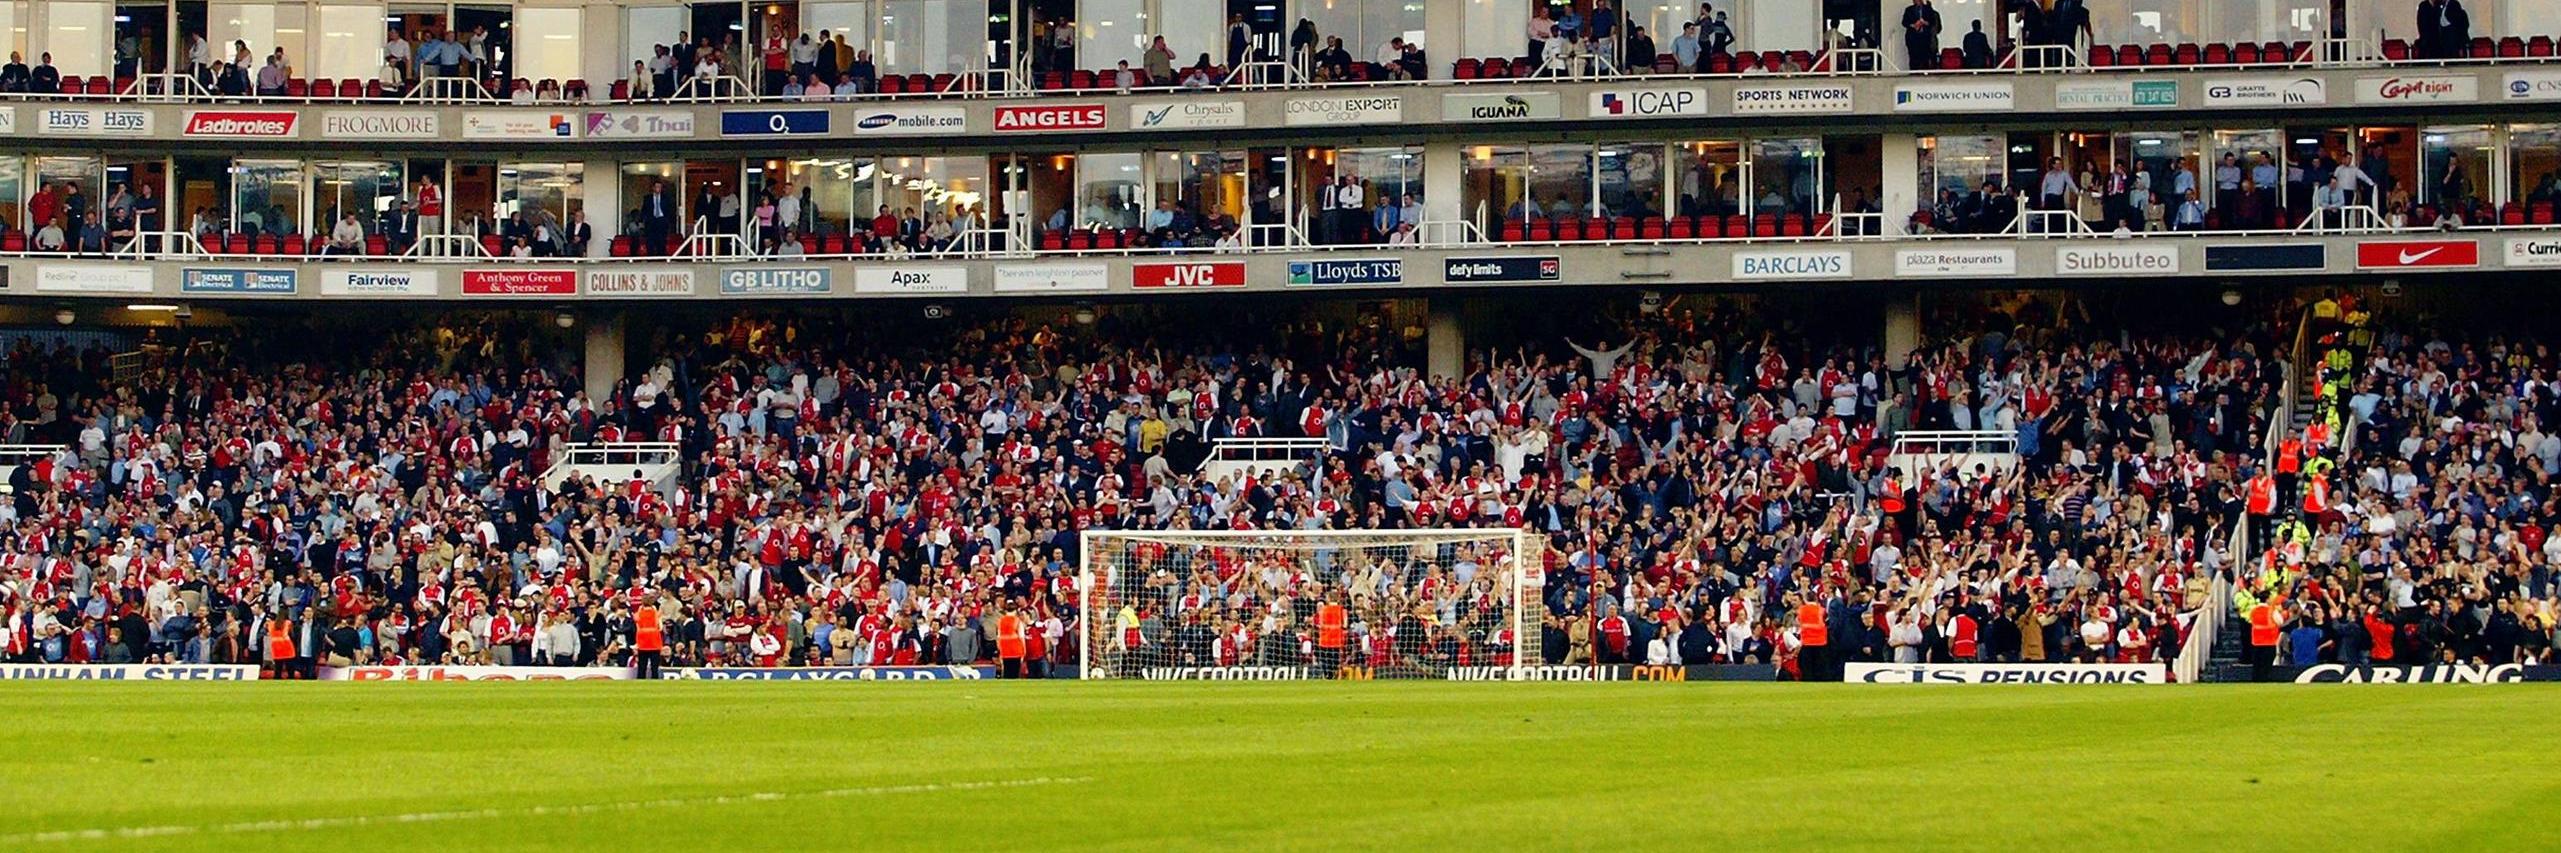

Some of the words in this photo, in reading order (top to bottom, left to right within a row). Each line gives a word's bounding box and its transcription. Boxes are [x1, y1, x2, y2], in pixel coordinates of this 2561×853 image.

[1631, 91, 1694, 114] ICAP
[1736, 90, 1783, 102] SPORTS
[1788, 89, 1849, 101] NETWORK
[1916, 92, 1970, 101] NORWICH
[1974, 91, 2010, 100] UNION
[1184, 102, 1235, 118] Chrysalis
[1287, 100, 1342, 114] LONDON
[1345, 98, 1400, 112] EXPORT
[1472, 106, 1527, 118] IGUANA
[50, 111, 89, 130] Hays
[104, 111, 144, 131] Hays
[193, 118, 286, 135] Ladbrokes
[327, 116, 434, 134] FROGMORE
[645, 115, 691, 133] Thai
[898, 115, 964, 127] mobile.com
[997, 109, 1103, 128] ANGELS
[1743, 256, 1842, 274] BARCLAYS
[1906, 253, 1936, 266] plaza
[1938, 255, 2003, 264] Restaurants
[2065, 252, 2170, 270] Subbuteo
[476, 272, 526, 285] Anthony
[528, 272, 562, 283] Green
[729, 271, 759, 287] GB
[760, 270, 822, 287] LITHO
[891, 271, 930, 286] Apax
[1164, 265, 1214, 286] JVC
[1317, 263, 1368, 283] Lloyds
[1371, 262, 1402, 278] TSB
[1449, 263, 1473, 278] defy
[1474, 264, 1503, 275] limits
[348, 274, 411, 286] Fairview
[591, 273, 637, 292] COLLINS
[640, 273, 649, 292] &
[652, 273, 690, 292] JOHNS
[490, 284, 502, 292] &
[505, 284, 549, 294] Spencer
[1980, 670, 2148, 684] PENSIONS
[2294, 663, 2523, 684] CARLING
